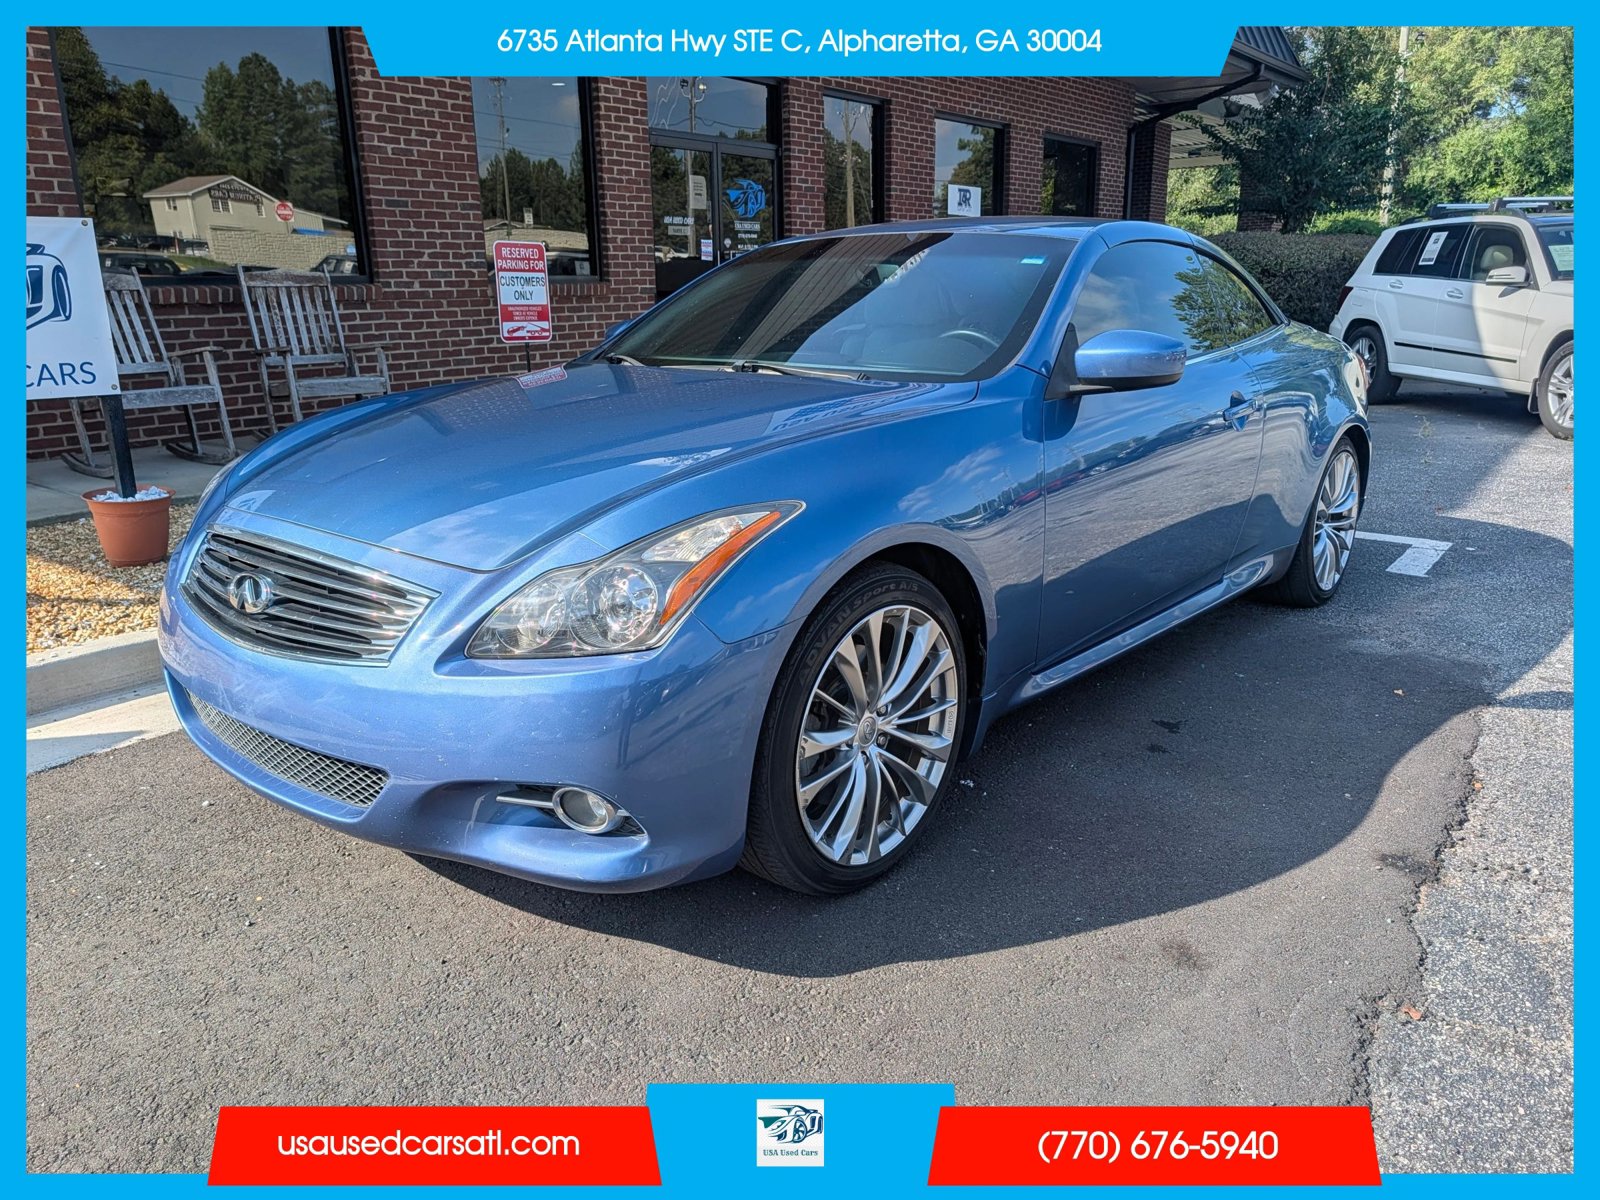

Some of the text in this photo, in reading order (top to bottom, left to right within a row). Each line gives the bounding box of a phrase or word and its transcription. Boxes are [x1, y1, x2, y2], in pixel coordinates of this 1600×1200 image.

[501, 247, 539, 259] RESERVED
[497, 259, 545, 270] PARKING FOR
[500, 275, 546, 287] CUSTOMERS
[513, 290, 534, 301] ONLY
